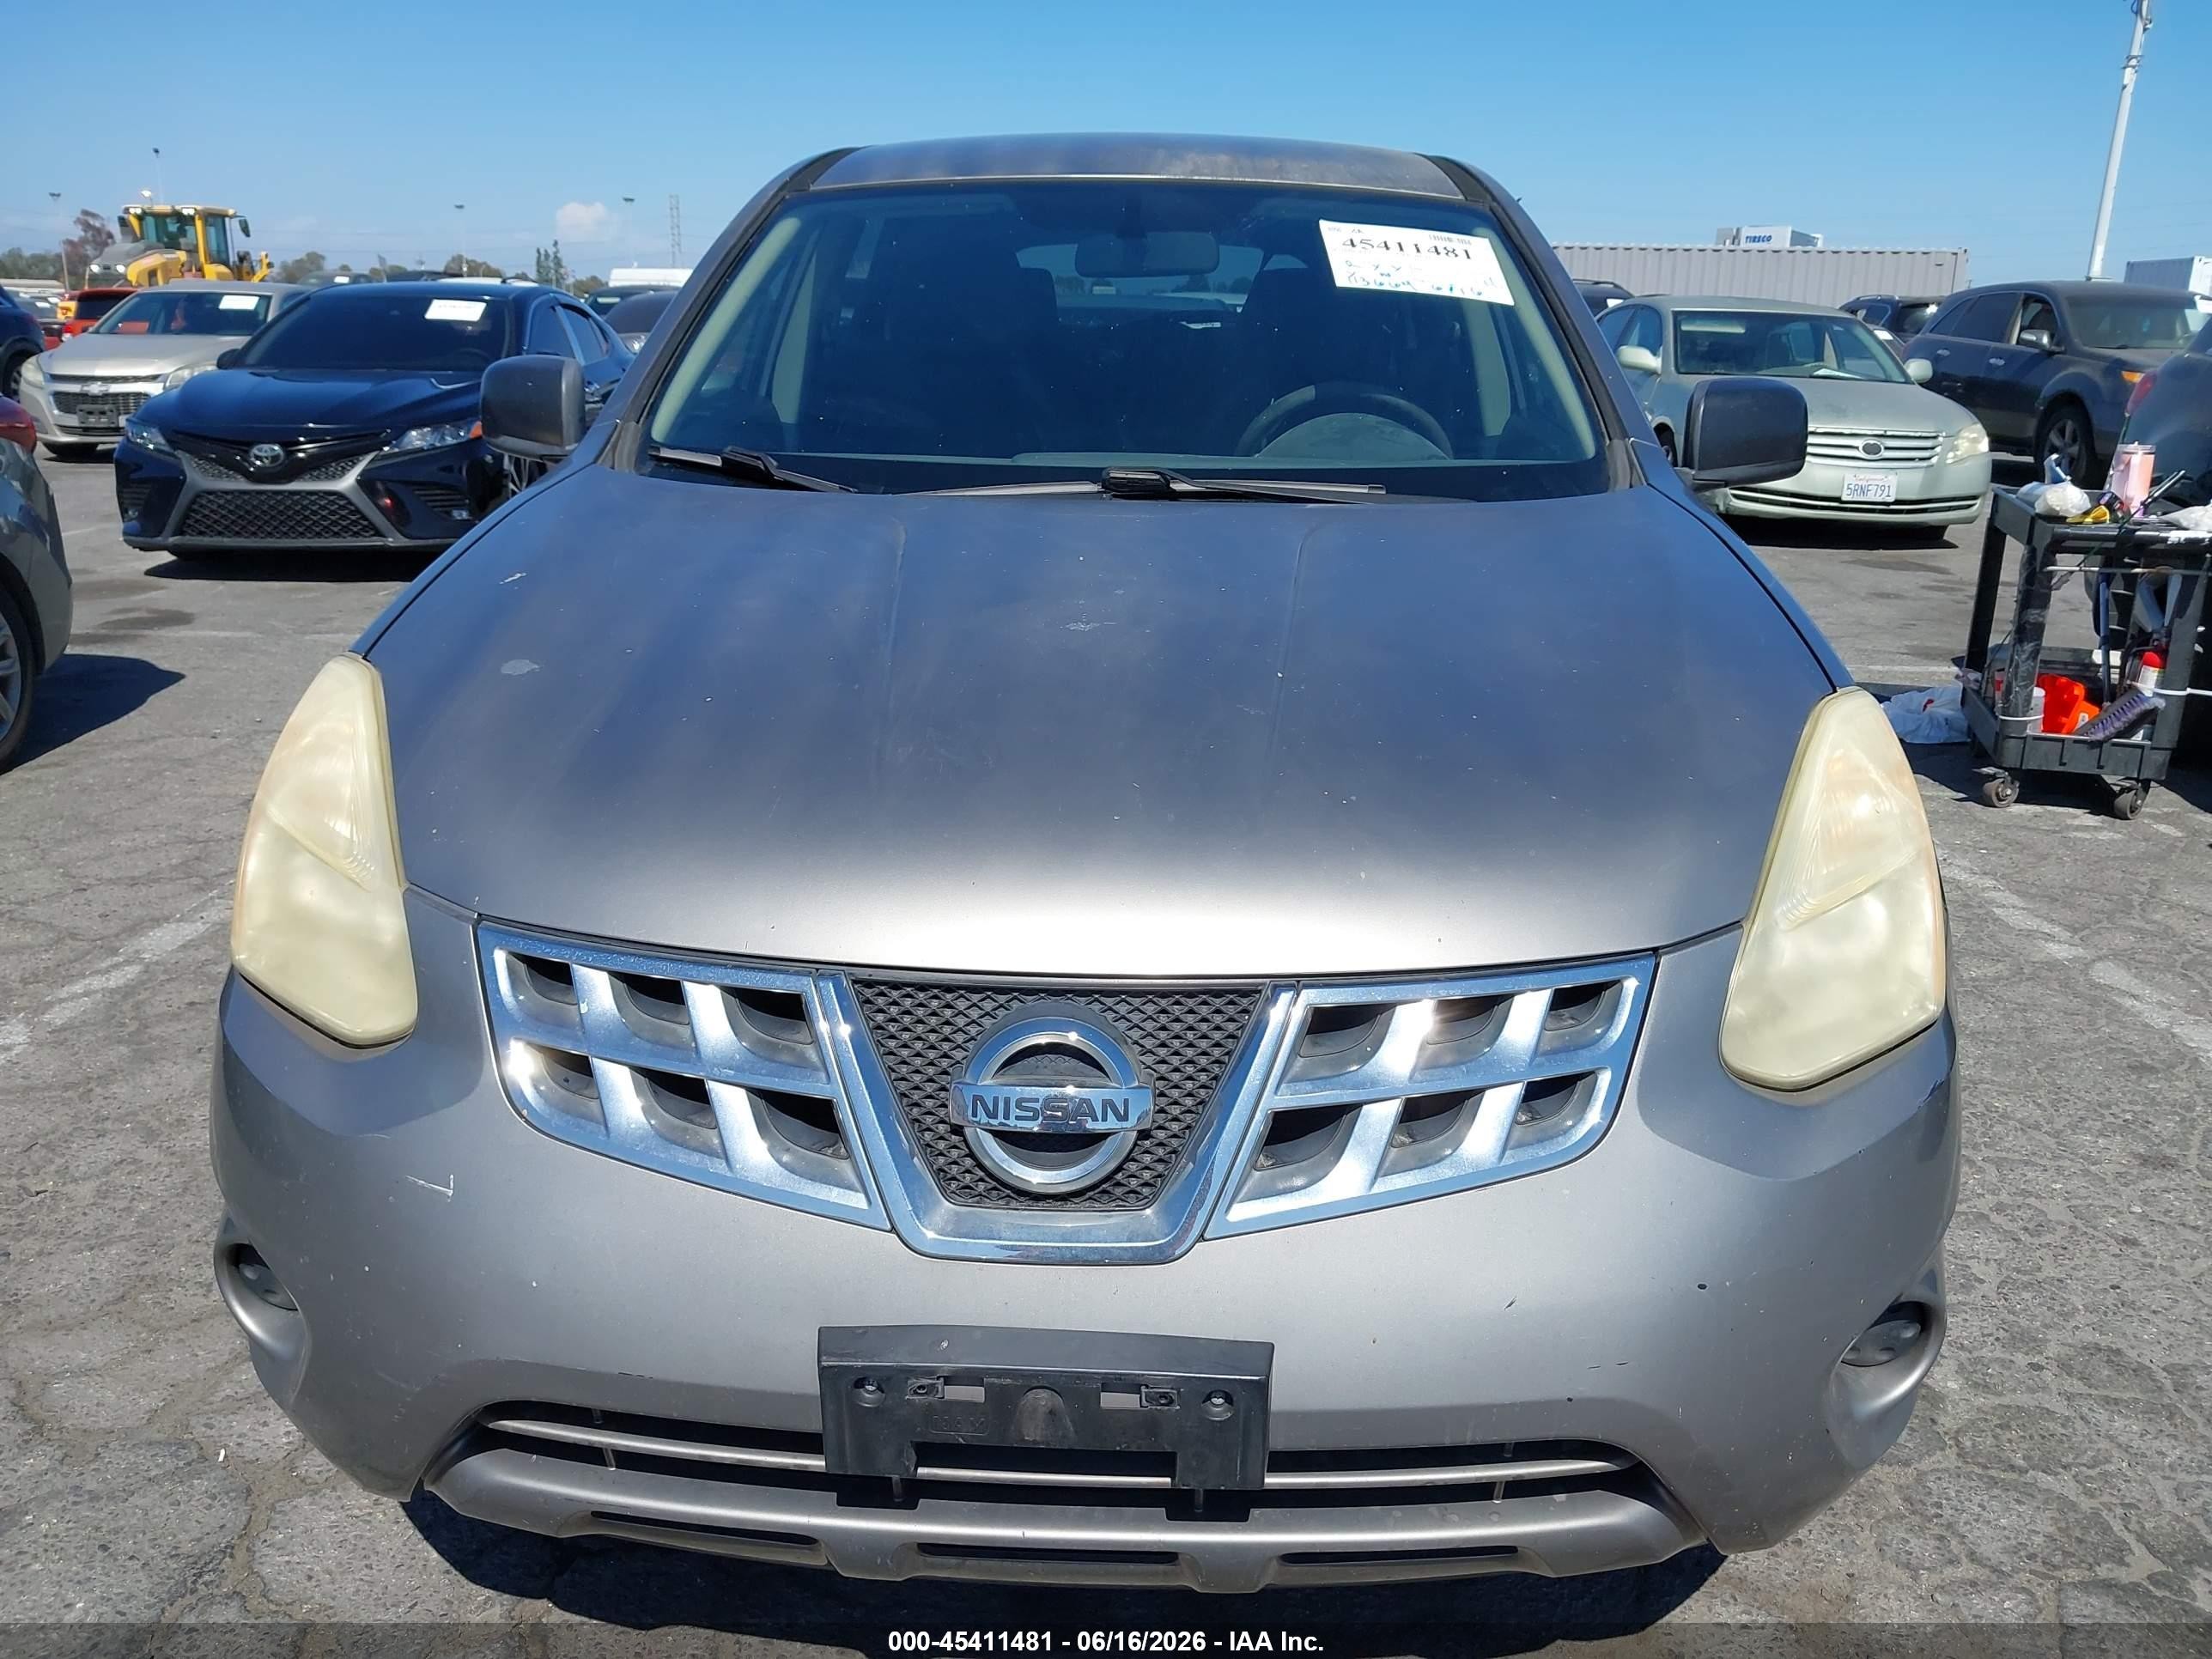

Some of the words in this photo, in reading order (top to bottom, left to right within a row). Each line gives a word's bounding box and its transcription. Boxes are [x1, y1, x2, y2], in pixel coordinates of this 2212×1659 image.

[1342, 238, 1471, 259] 45411481
[1846, 483, 1892, 498] 5RNF791
[970, 1094, 1130, 1123] NISSAN
